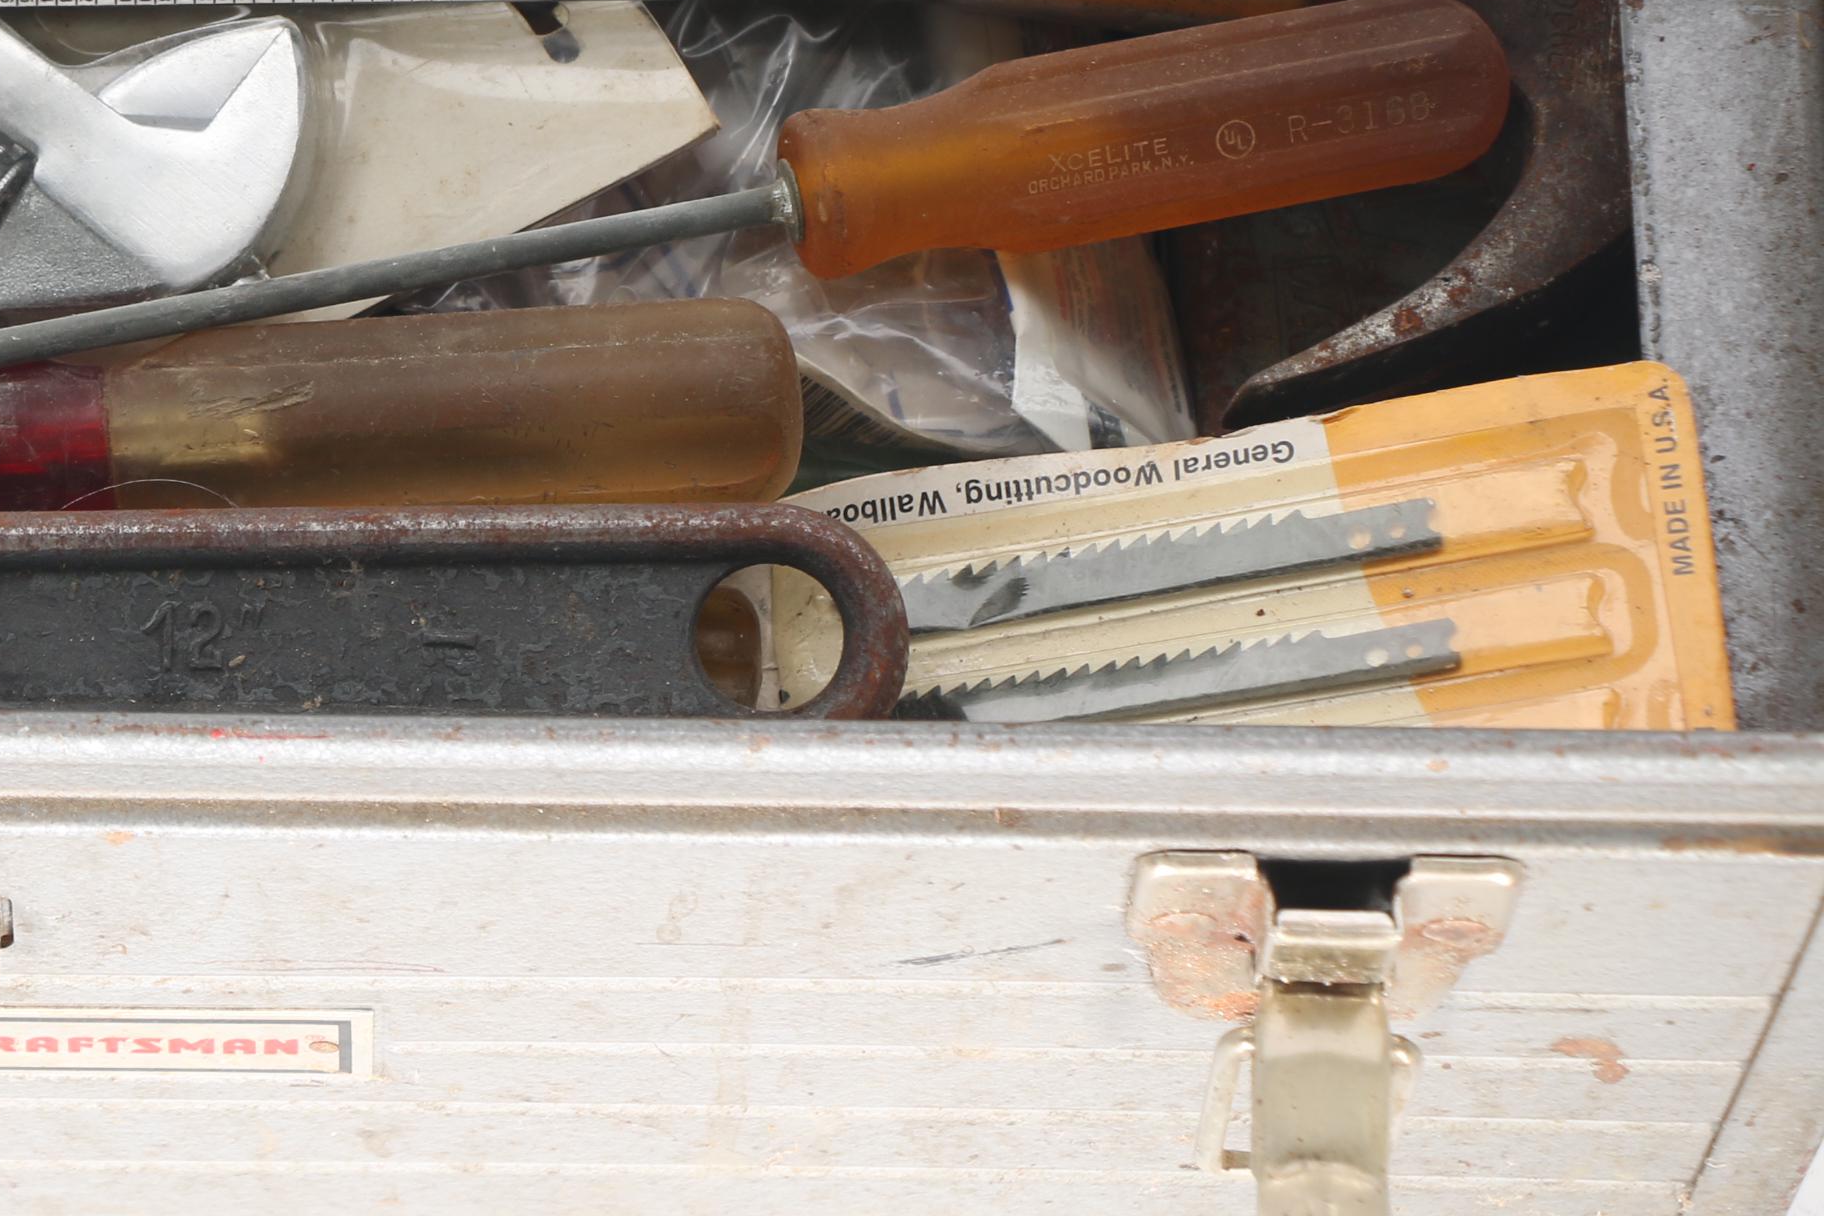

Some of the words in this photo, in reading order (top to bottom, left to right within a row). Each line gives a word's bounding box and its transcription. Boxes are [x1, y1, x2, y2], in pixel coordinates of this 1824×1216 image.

[1047, 136, 1170, 174] XCELITE
[1028, 165, 1106, 195] ORCHARD
[1648, 378, 1678, 454] U.S.A.
[1174, 440, 1294, 481] General
[1659, 463, 1684, 490] IN
[954, 461, 1163, 508] Woodcutting,
[1664, 499, 1697, 575] MADE
